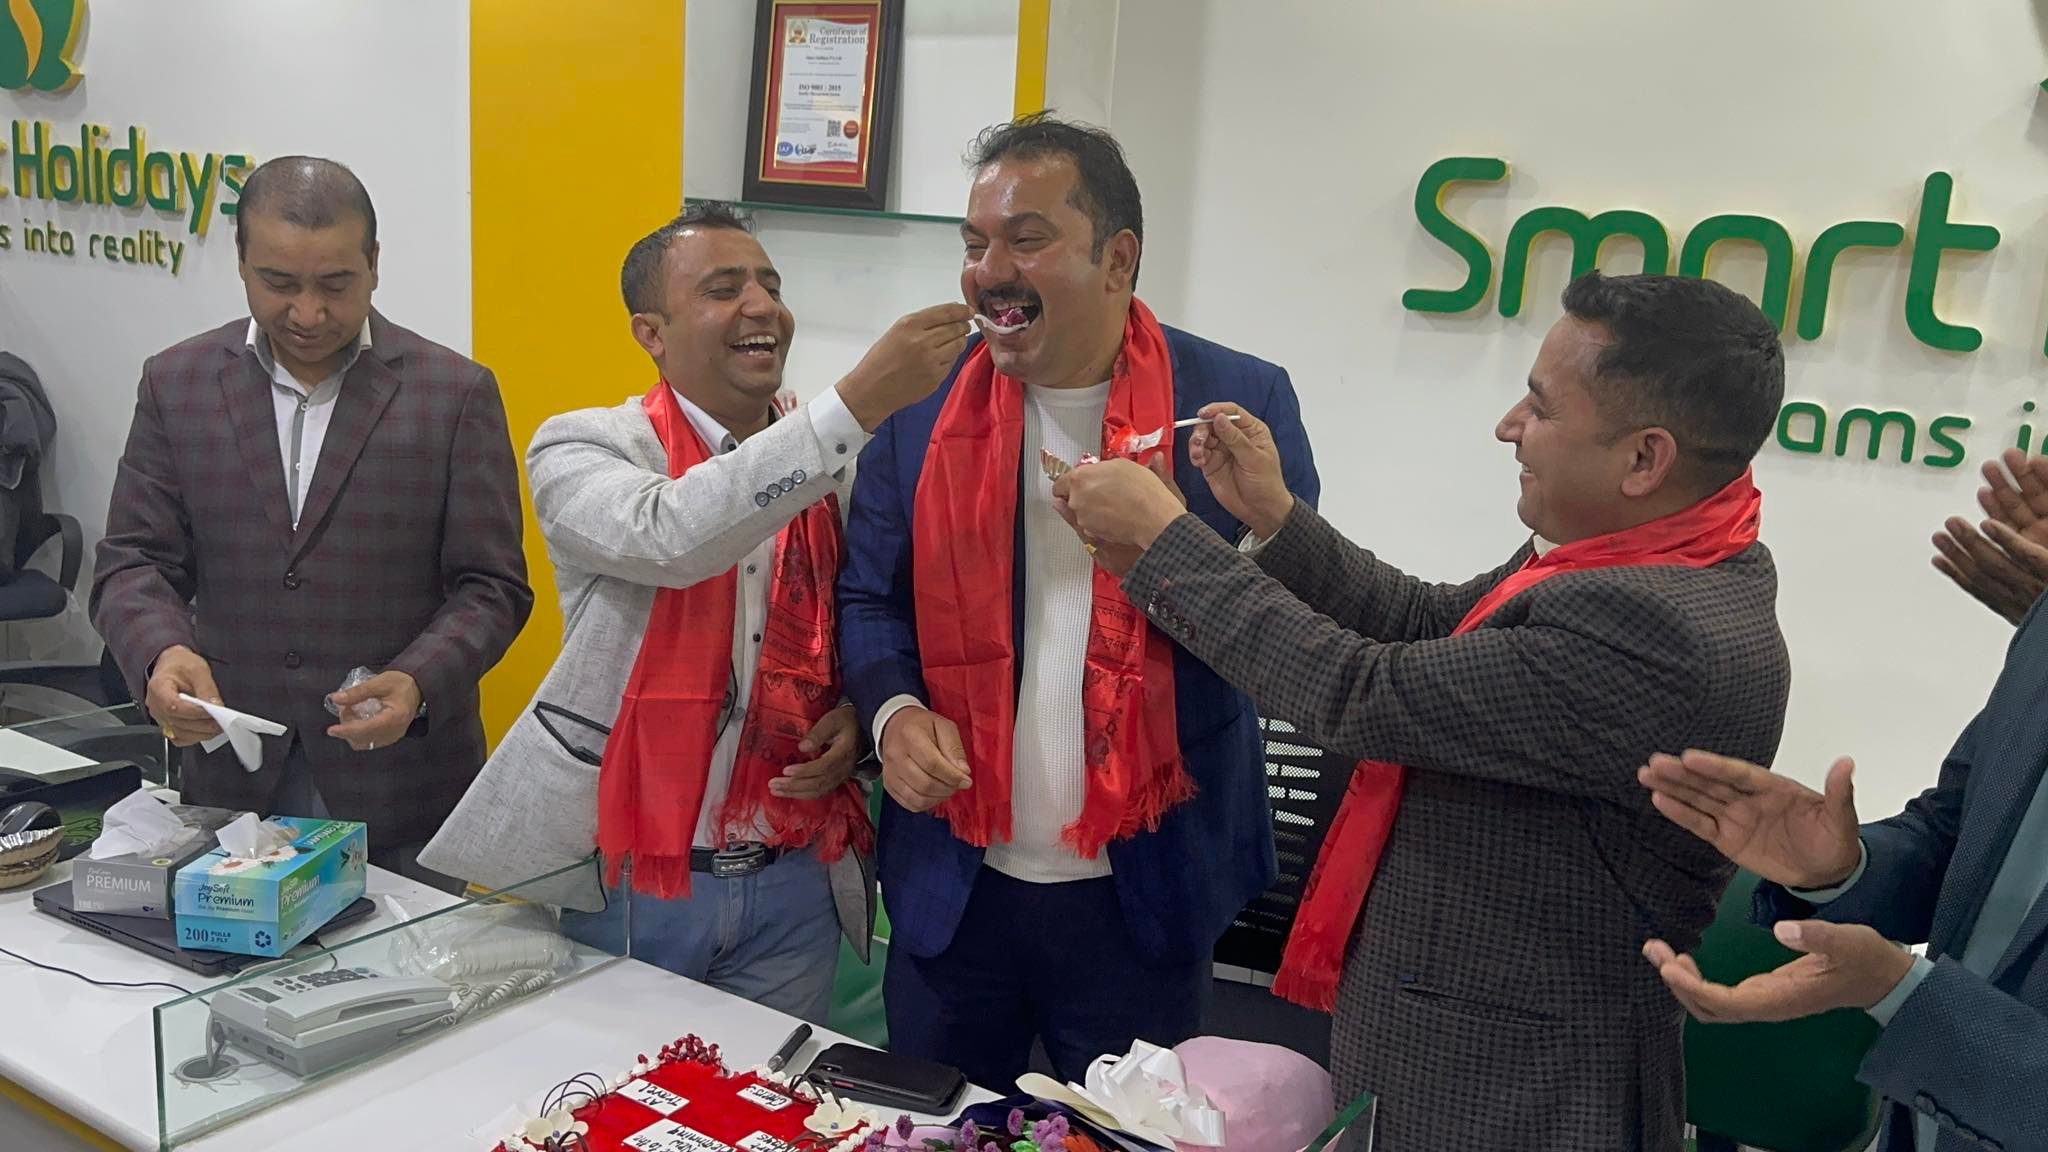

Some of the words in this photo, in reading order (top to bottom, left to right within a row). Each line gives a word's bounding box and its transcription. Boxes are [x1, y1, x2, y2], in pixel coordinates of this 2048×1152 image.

[810, 33, 866, 45] Registration
[11, 119, 253, 236] Holidays
[23, 218, 75, 257] into
[89, 229, 185, 276] reality
[1402, 156, 2001, 352] Smart
[1776, 401, 1973, 468] ams
[86, 874, 151, 893] PREMIUM
[198, 892, 255, 908] Premium
[184, 927, 209, 942] 200
[638, 1083, 682, 1107] Travel
